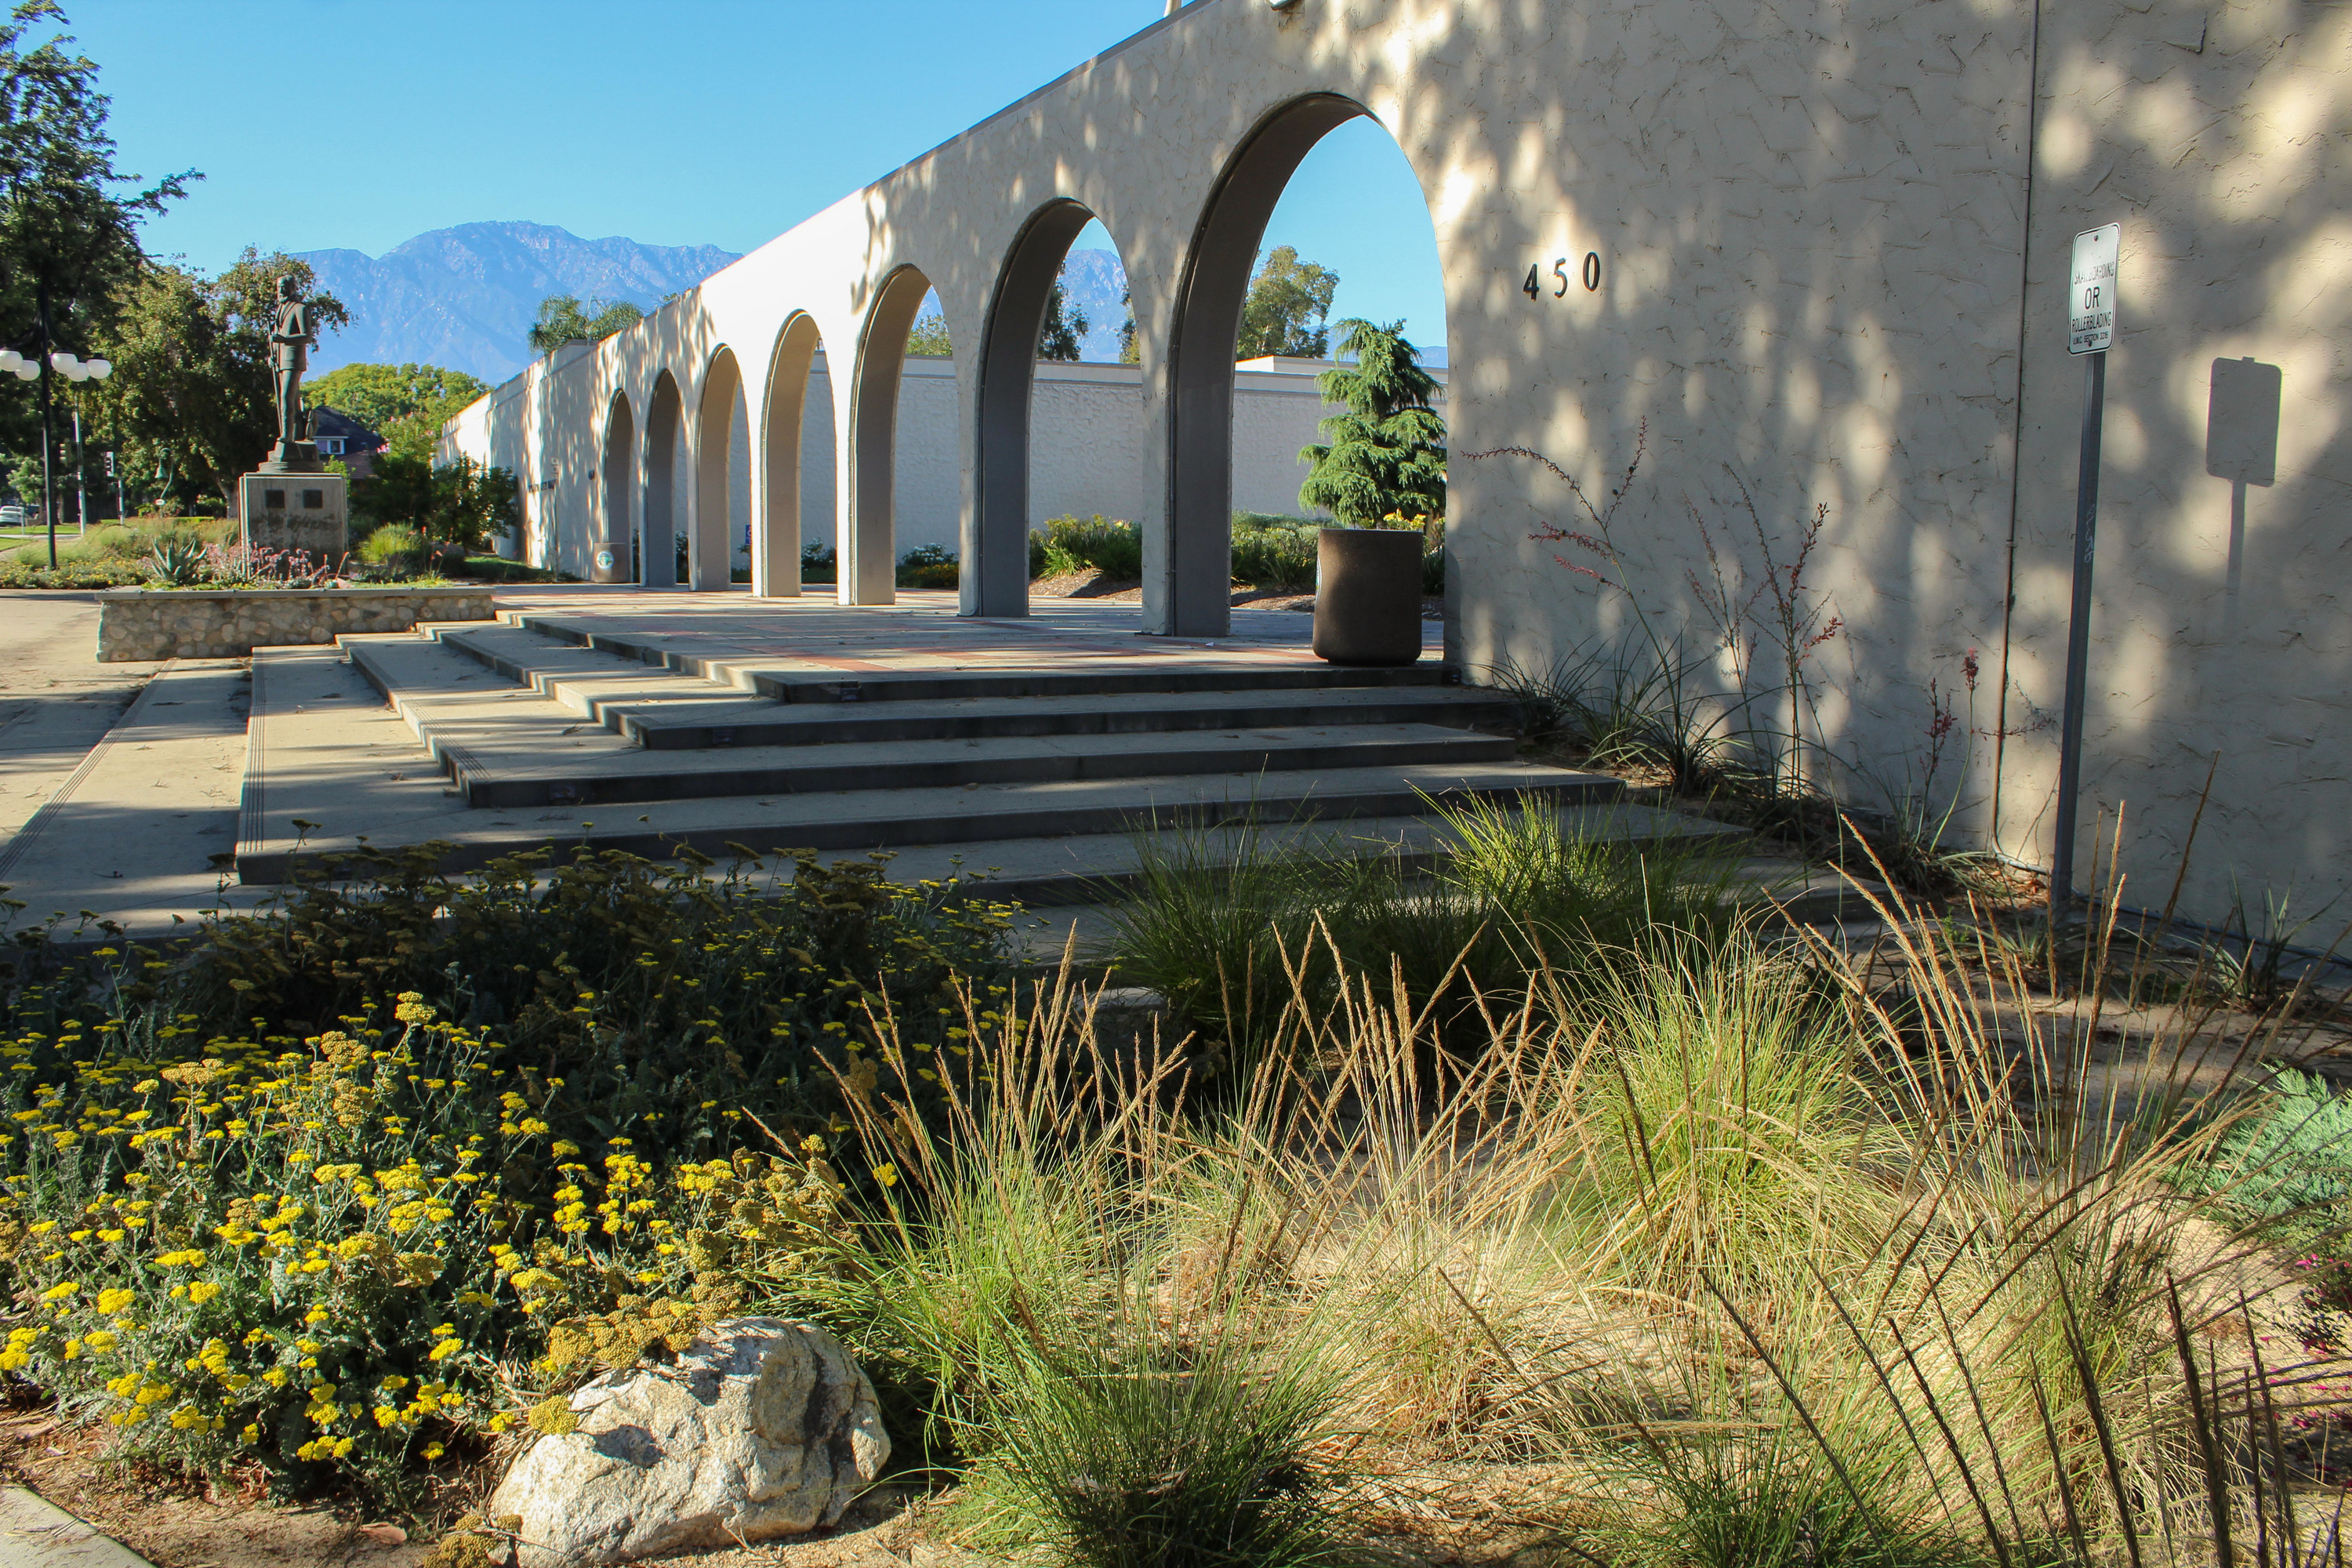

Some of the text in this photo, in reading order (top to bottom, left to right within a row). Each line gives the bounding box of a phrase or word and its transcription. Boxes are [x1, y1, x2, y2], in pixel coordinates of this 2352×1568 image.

[1523, 251, 1600, 301] 450
[2085, 285, 2100, 310] OR
[2072, 311, 2111, 332] ROLLERBLADING
[2084, 333, 2099, 343] SECTION
